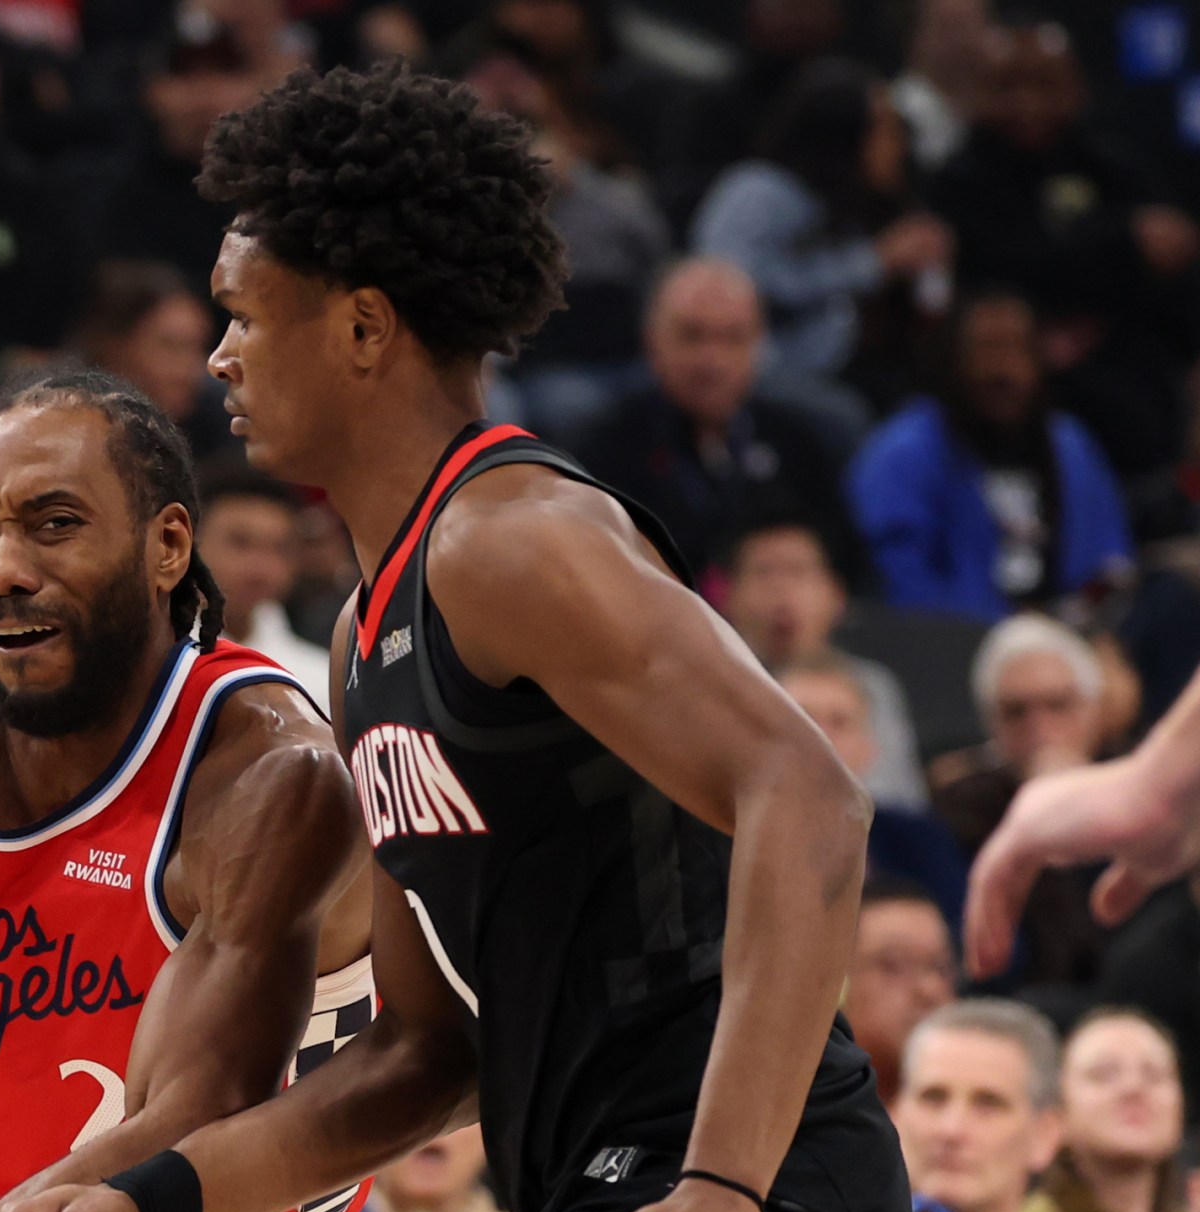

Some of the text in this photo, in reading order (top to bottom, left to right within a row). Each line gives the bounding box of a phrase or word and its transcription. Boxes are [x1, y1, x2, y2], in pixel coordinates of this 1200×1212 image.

[350, 722, 490, 848] OUSTON
[63, 860, 132, 890] RWANDA
[88, 848, 126, 870] VISIT
[58, 1058, 127, 1153] 2
